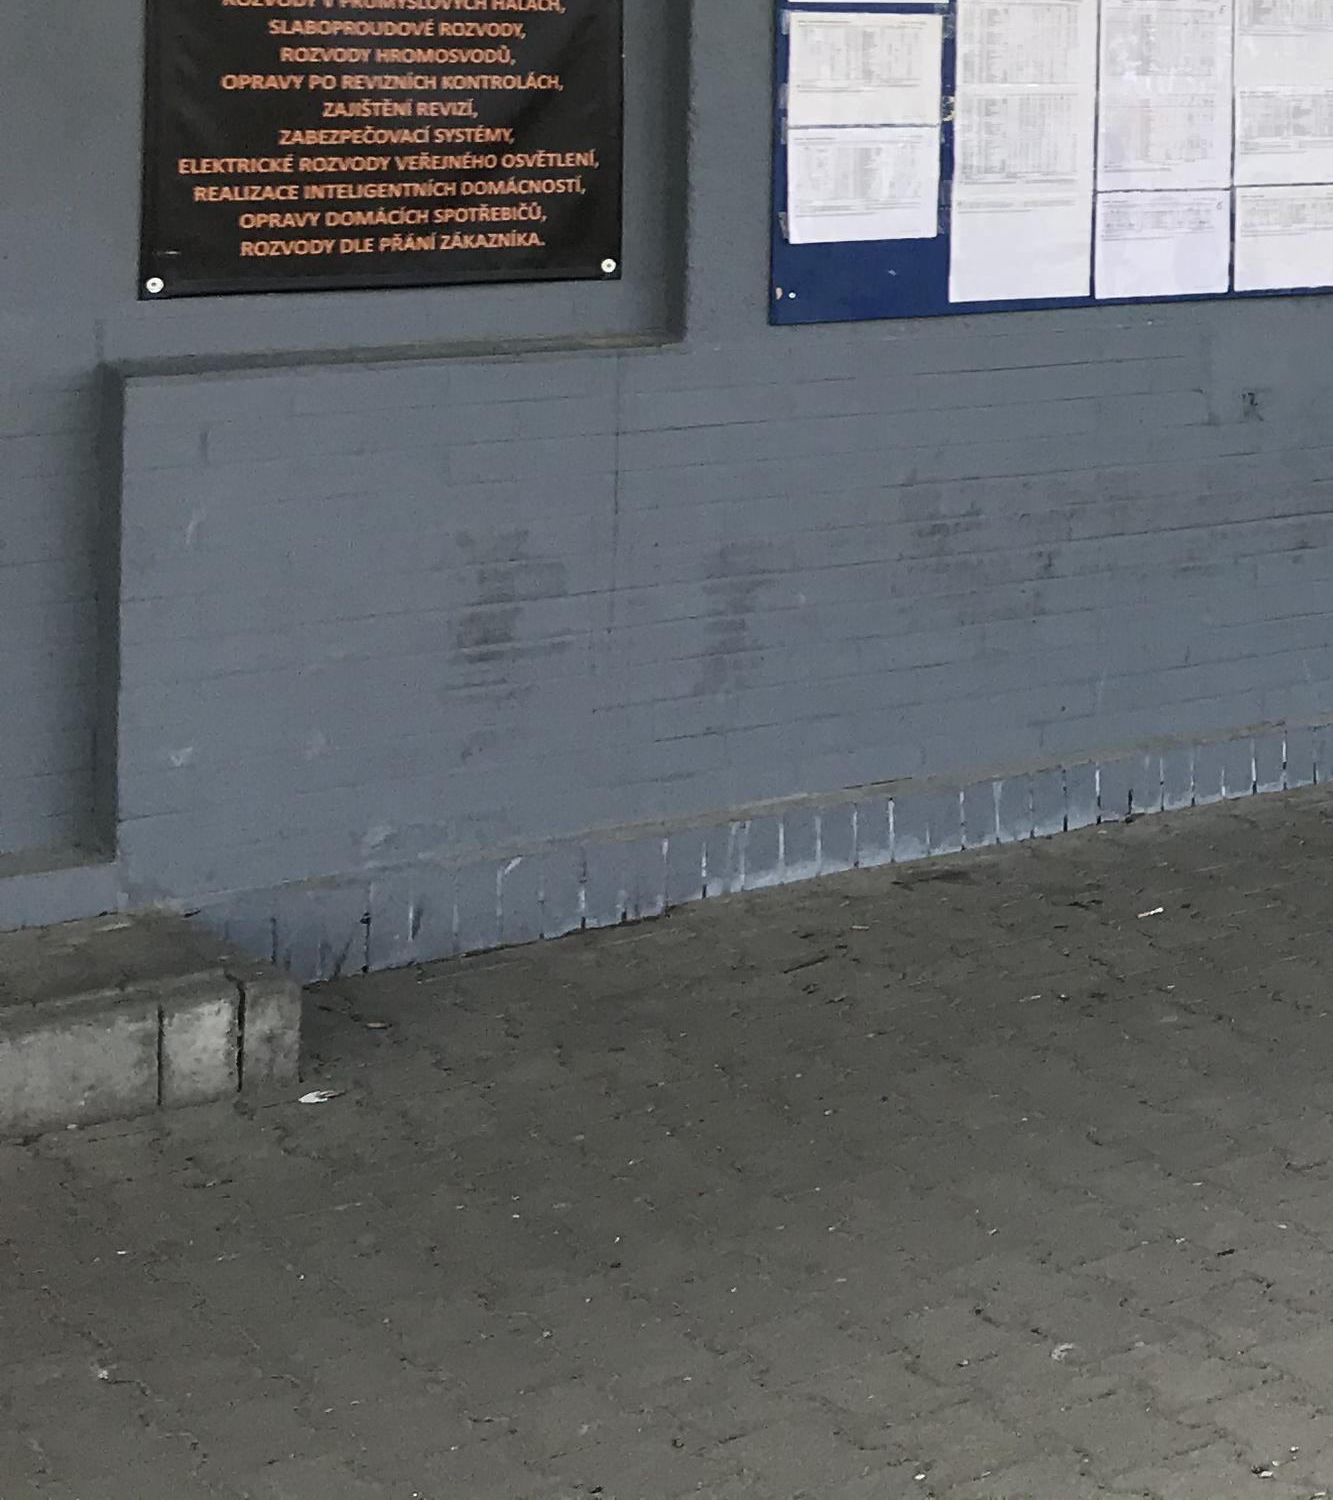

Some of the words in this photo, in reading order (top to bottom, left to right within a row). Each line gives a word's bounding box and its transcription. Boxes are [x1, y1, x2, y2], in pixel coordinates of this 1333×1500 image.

[268, 18, 434, 37] SLABOPROUDOVÉ
[439, 22, 526, 39] ROZVODY,
[280, 47, 372, 63] ROZVODY
[375, 44, 516, 66] HROMOSVODŮ,
[221, 74, 305, 90] OPRAVY
[308, 75, 337, 90] PO
[341, 72, 437, 90] REVIZNÍCH
[441, 71, 564, 91] KONTROLÁCH,
[322, 98, 412, 118] ZAJIŠTĚNÍ
[416, 98, 478, 119] REVIZÍ,
[278, 125, 430, 145] ZABEZPEČOVACÍ
[434, 125, 515, 145] SYSTÉMY,
[178, 154, 294, 174] ELEKTRICKÉ
[299, 156, 392, 173] ROZVODY
[395, 151, 497, 171] VEŘEJNÉHO
[501, 148, 600, 170] OSVĚTLENÍ,
[193, 185, 300, 202] REALIZACE
[303, 178, 456, 199] INTELIGENTNÍCH
[461, 175, 586, 196] DOMÁCNOSTÍ,
[239, 212, 320, 229] OPRAVY
[325, 206, 429, 226] DOMÁCÍCH
[433, 201, 547, 224] SPOTŘEBIČŮ,
[239, 239, 336, 256] ROZVODY
[339, 238, 374, 253] DLE
[379, 232, 435, 252] PŘÁNÍ
[440, 229, 545, 250] ZÁKAZNÍKA.
